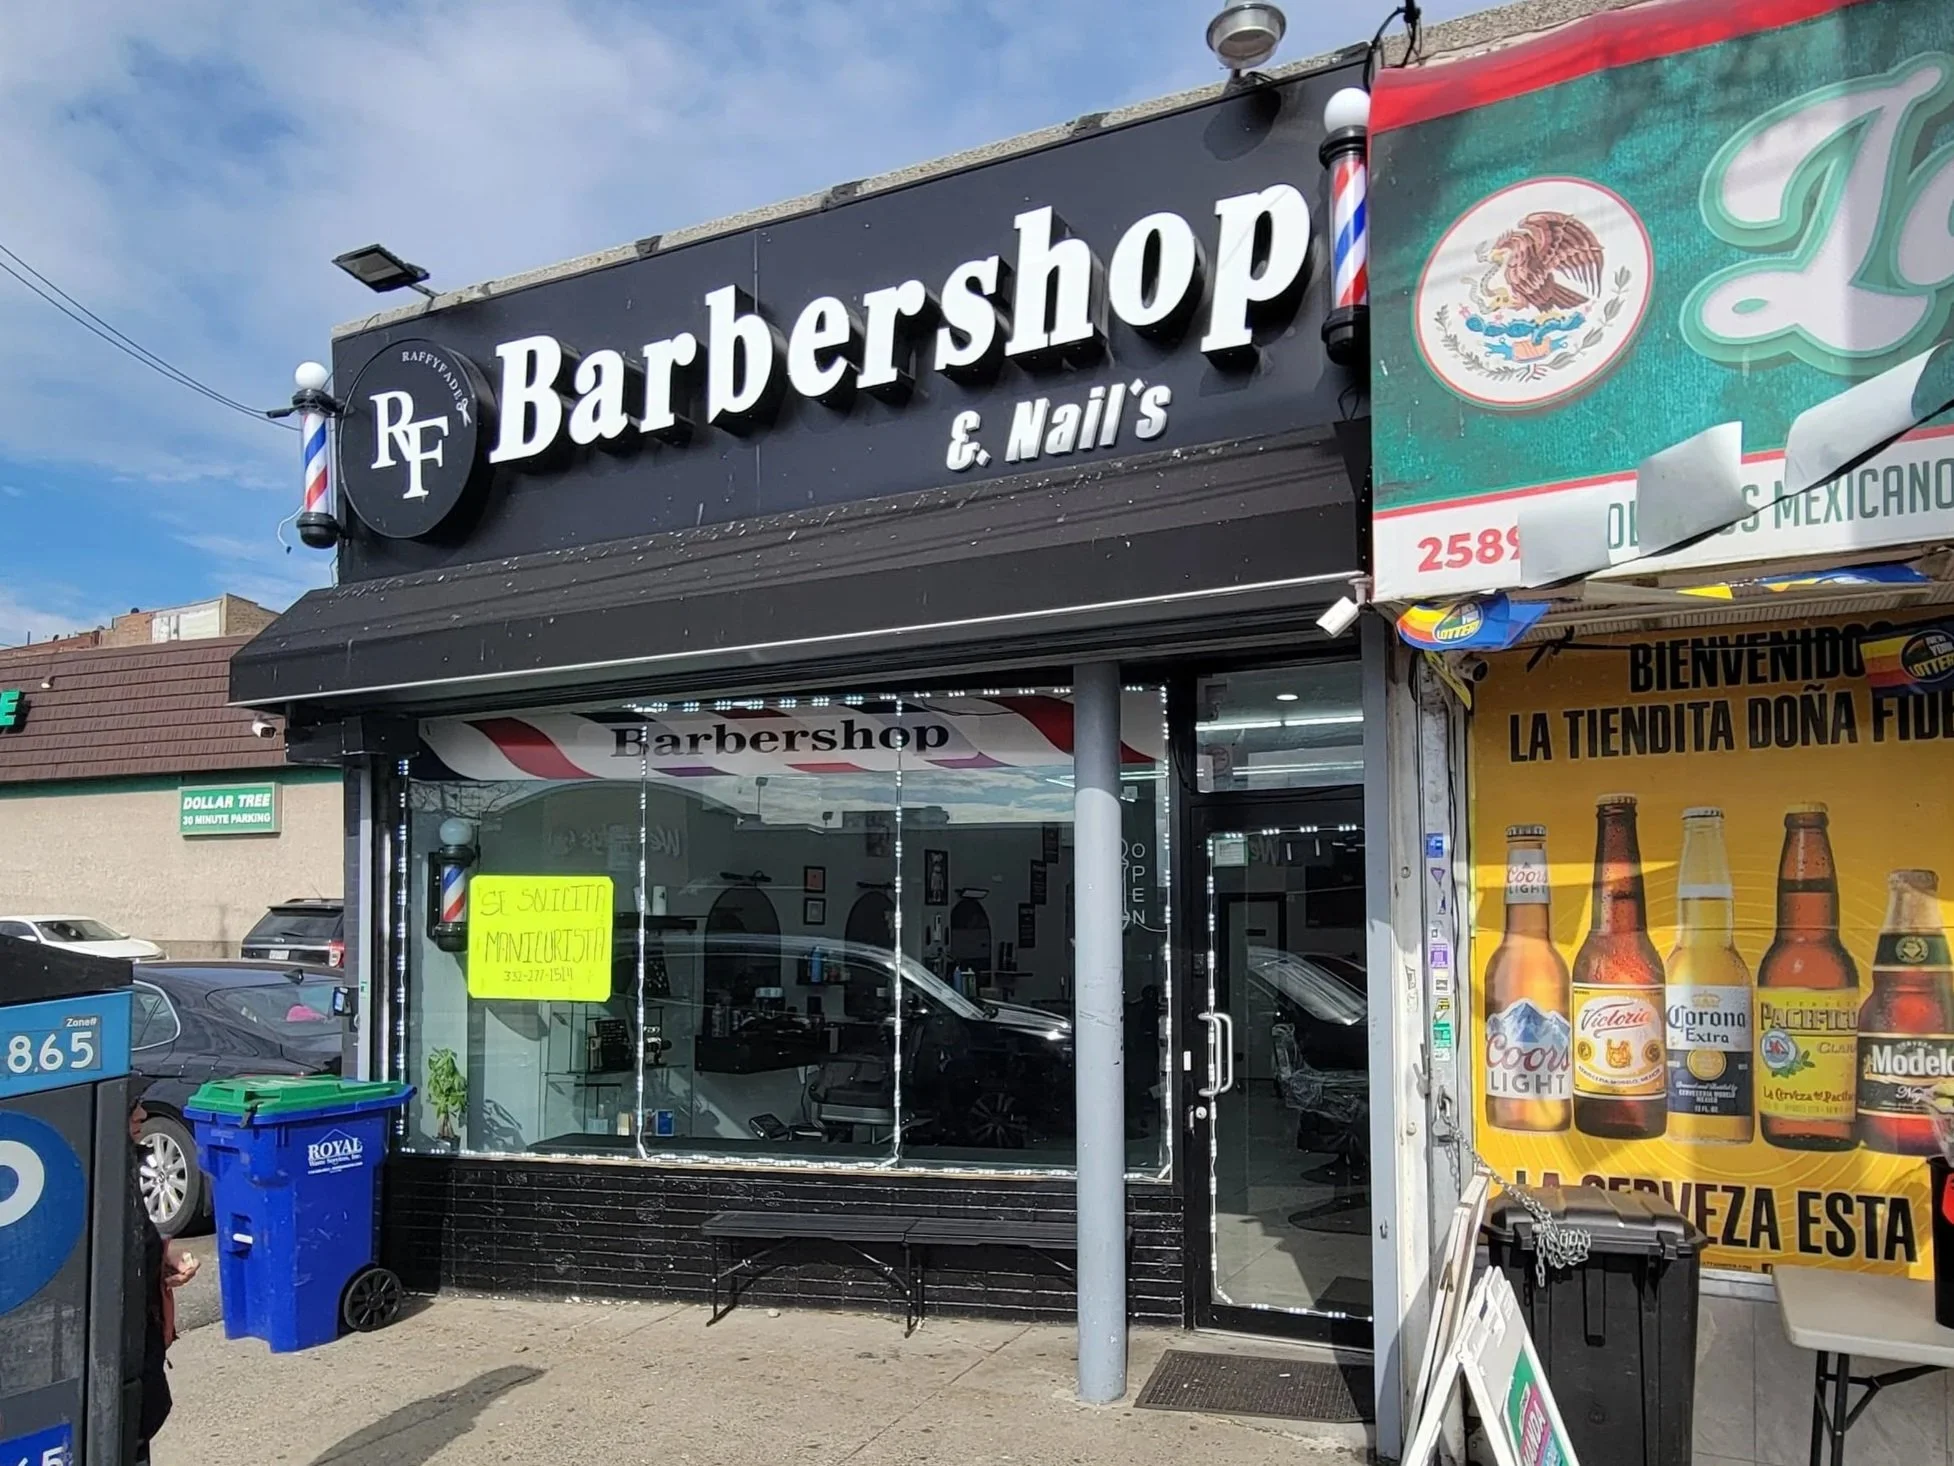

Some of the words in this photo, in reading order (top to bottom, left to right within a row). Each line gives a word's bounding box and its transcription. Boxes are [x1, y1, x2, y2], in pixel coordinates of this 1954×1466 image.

[488, 182, 1312, 465] Barbershop
[1005, 378, 1172, 463] Nail's
[1630, 621, 1895, 693] BIENVENIDO
[610, 718, 949, 758] Barbershop
[1510, 713, 1551, 763] LA
[1563, 700, 1735, 761] TIENDITA
[1748, 683, 1857, 750] DOÑA
[183, 795, 233, 810] DOLLAR
[238, 793, 271, 807] TREE
[182, 815, 193, 825] 30
[195, 814, 230, 825] MINUTE
[231, 812, 271, 824] PARKING
[1131, 842, 1146, 925] OPEN
[1506, 866, 1548, 884] Coors
[1508, 884, 1547, 894] LIGHT
[480, 890, 510, 916] SE
[484, 927, 606, 963] MANICURISTA
[1667, 1004, 1746, 1030] Corona
[1684, 1028, 1730, 1044] Extra
[1486, 1032, 1570, 1073] Coors
[1490, 1071, 1566, 1095] LIGHT
[308, 1138, 363, 1160] ROYAL
[1582, 1174, 1781, 1250] VEZA
[1800, 1191, 1919, 1263] ESTA
